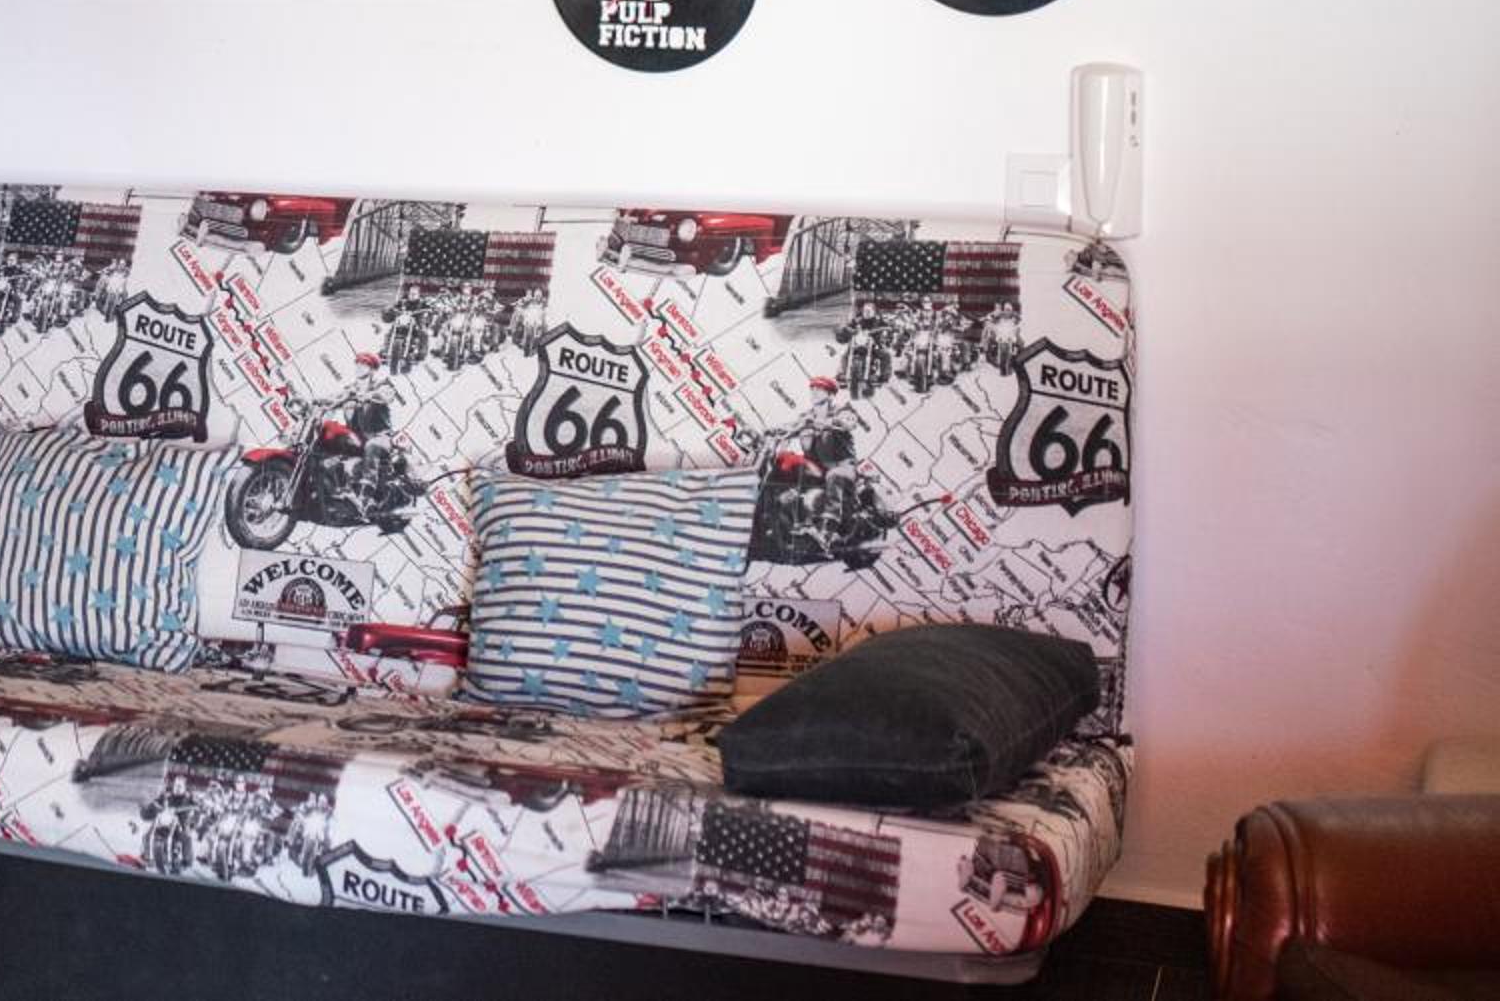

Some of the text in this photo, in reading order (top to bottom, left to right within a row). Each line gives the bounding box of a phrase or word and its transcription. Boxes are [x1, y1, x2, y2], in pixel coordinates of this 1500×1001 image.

[600, 0, 672, 25] PULP
[598, 24, 707, 51] FICTION
[134, 313, 197, 351] ROUTE
[117, 350, 194, 419] 66
[559, 347, 630, 383] ROUTE
[1040, 363, 1119, 400] ROUTE
[543, 384, 630, 457] 66
[1028, 404, 1122, 482] 66
[906, 521, 952, 570] Springfield
[955, 507, 991, 546] Chicago
[242, 558, 366, 611] WELCOME
[342, 870, 426, 912] ROUTE
